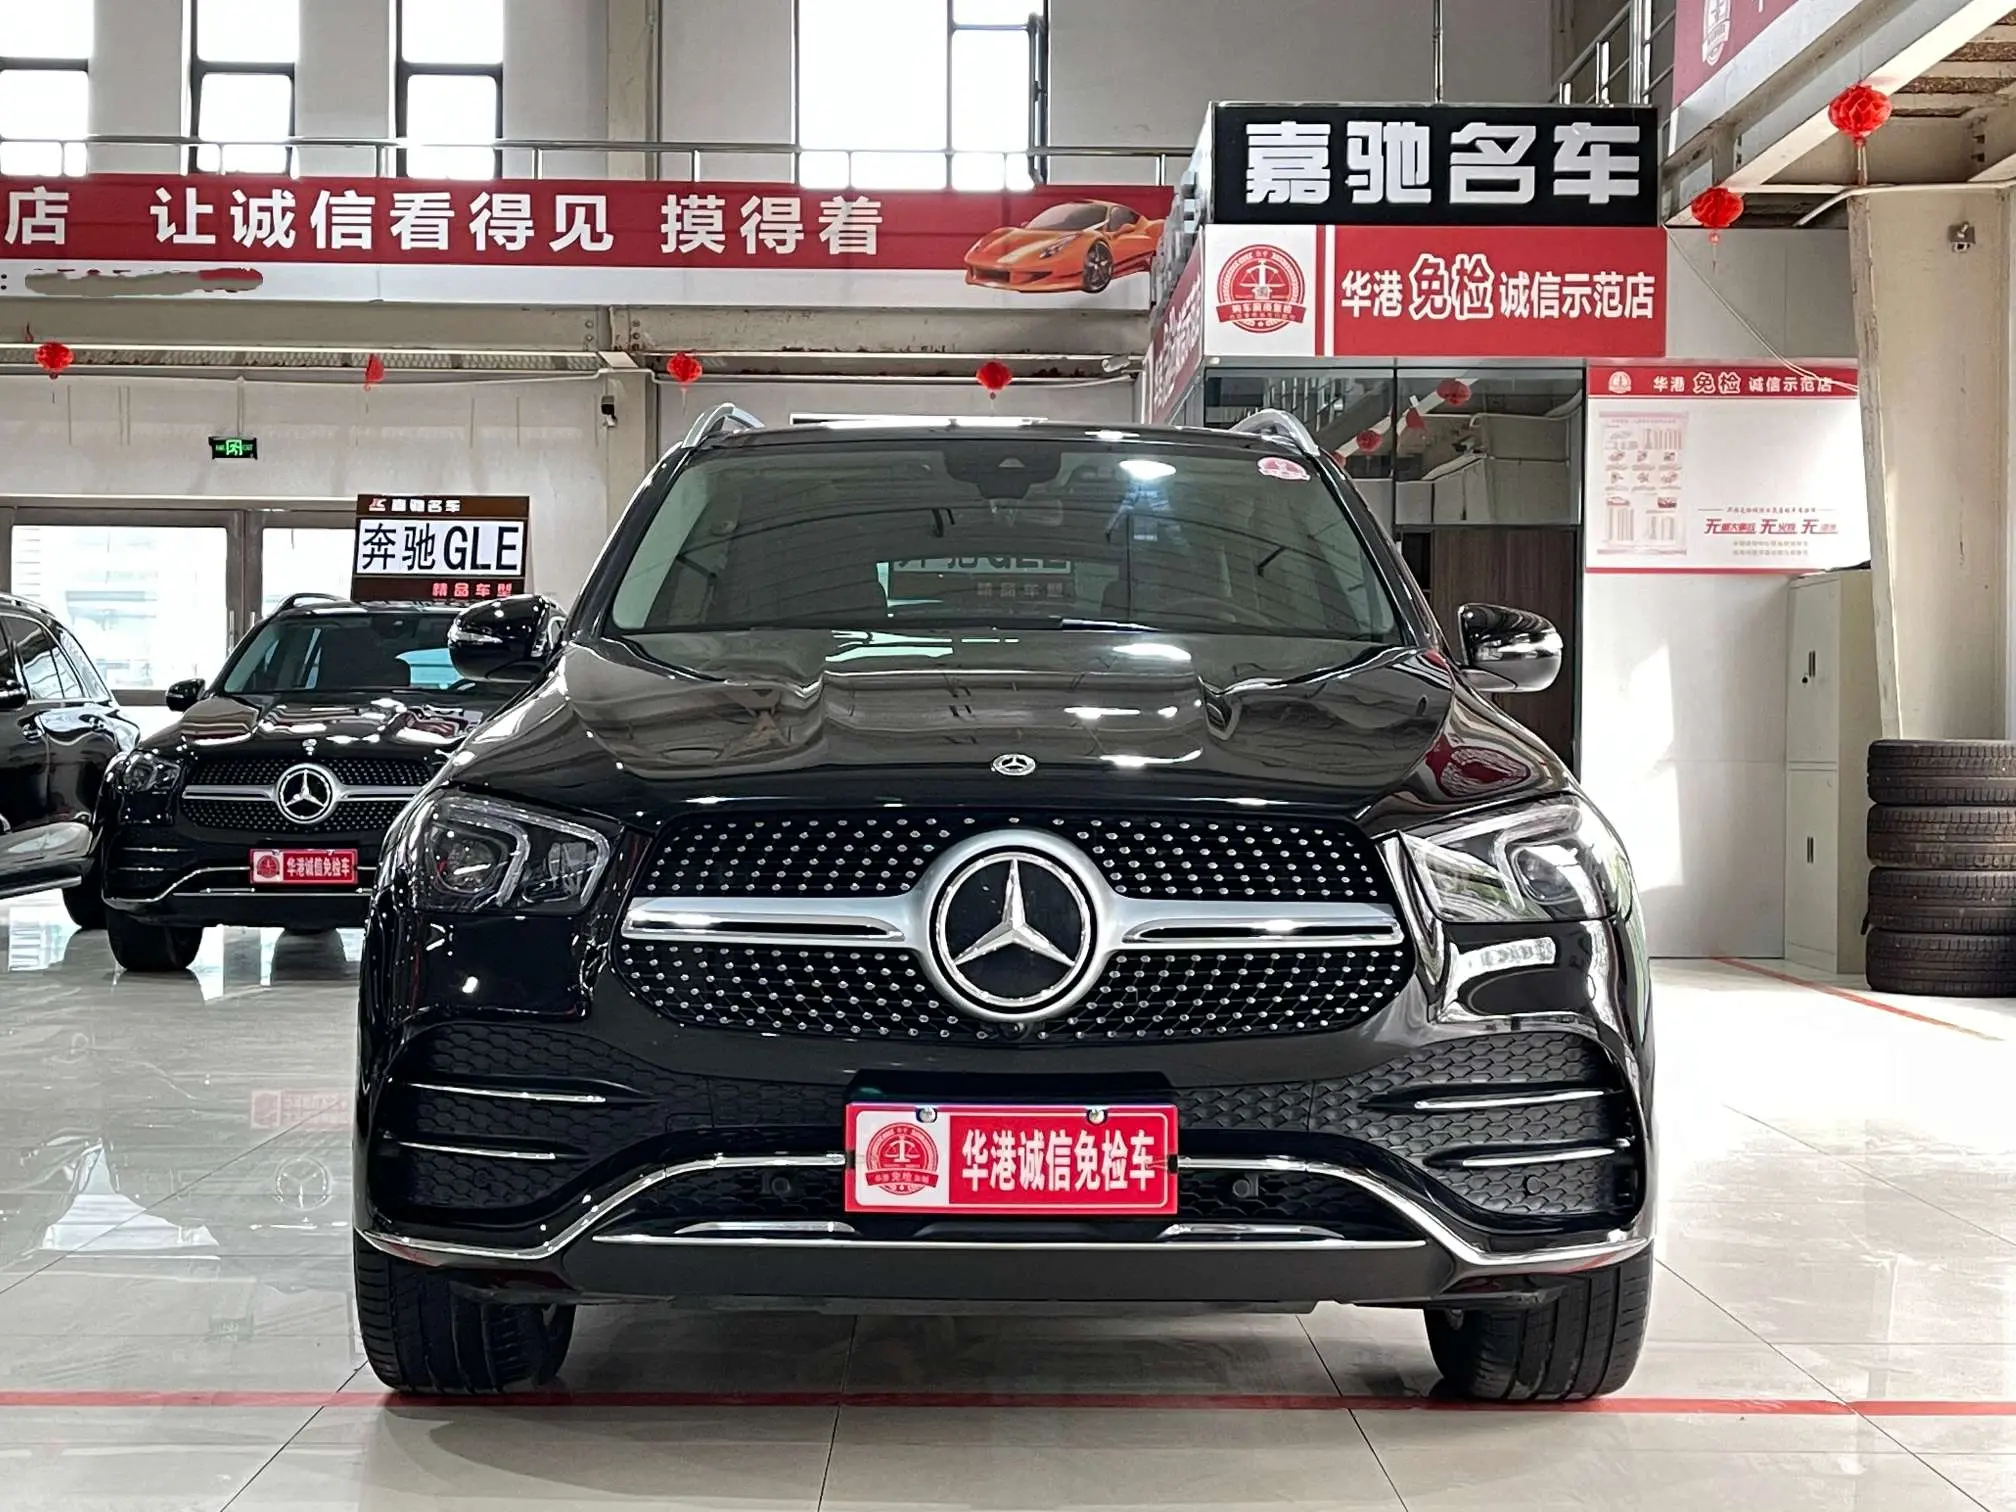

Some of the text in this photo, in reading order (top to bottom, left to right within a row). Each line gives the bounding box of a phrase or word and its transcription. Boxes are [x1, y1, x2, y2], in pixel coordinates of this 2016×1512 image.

[1246, 121, 1640, 205] 嘉驰名车
[5, 186, 883, 255] 店 让诚信看得见 摸得着
[961, 1129, 1155, 1192] 华港诚信免检车
